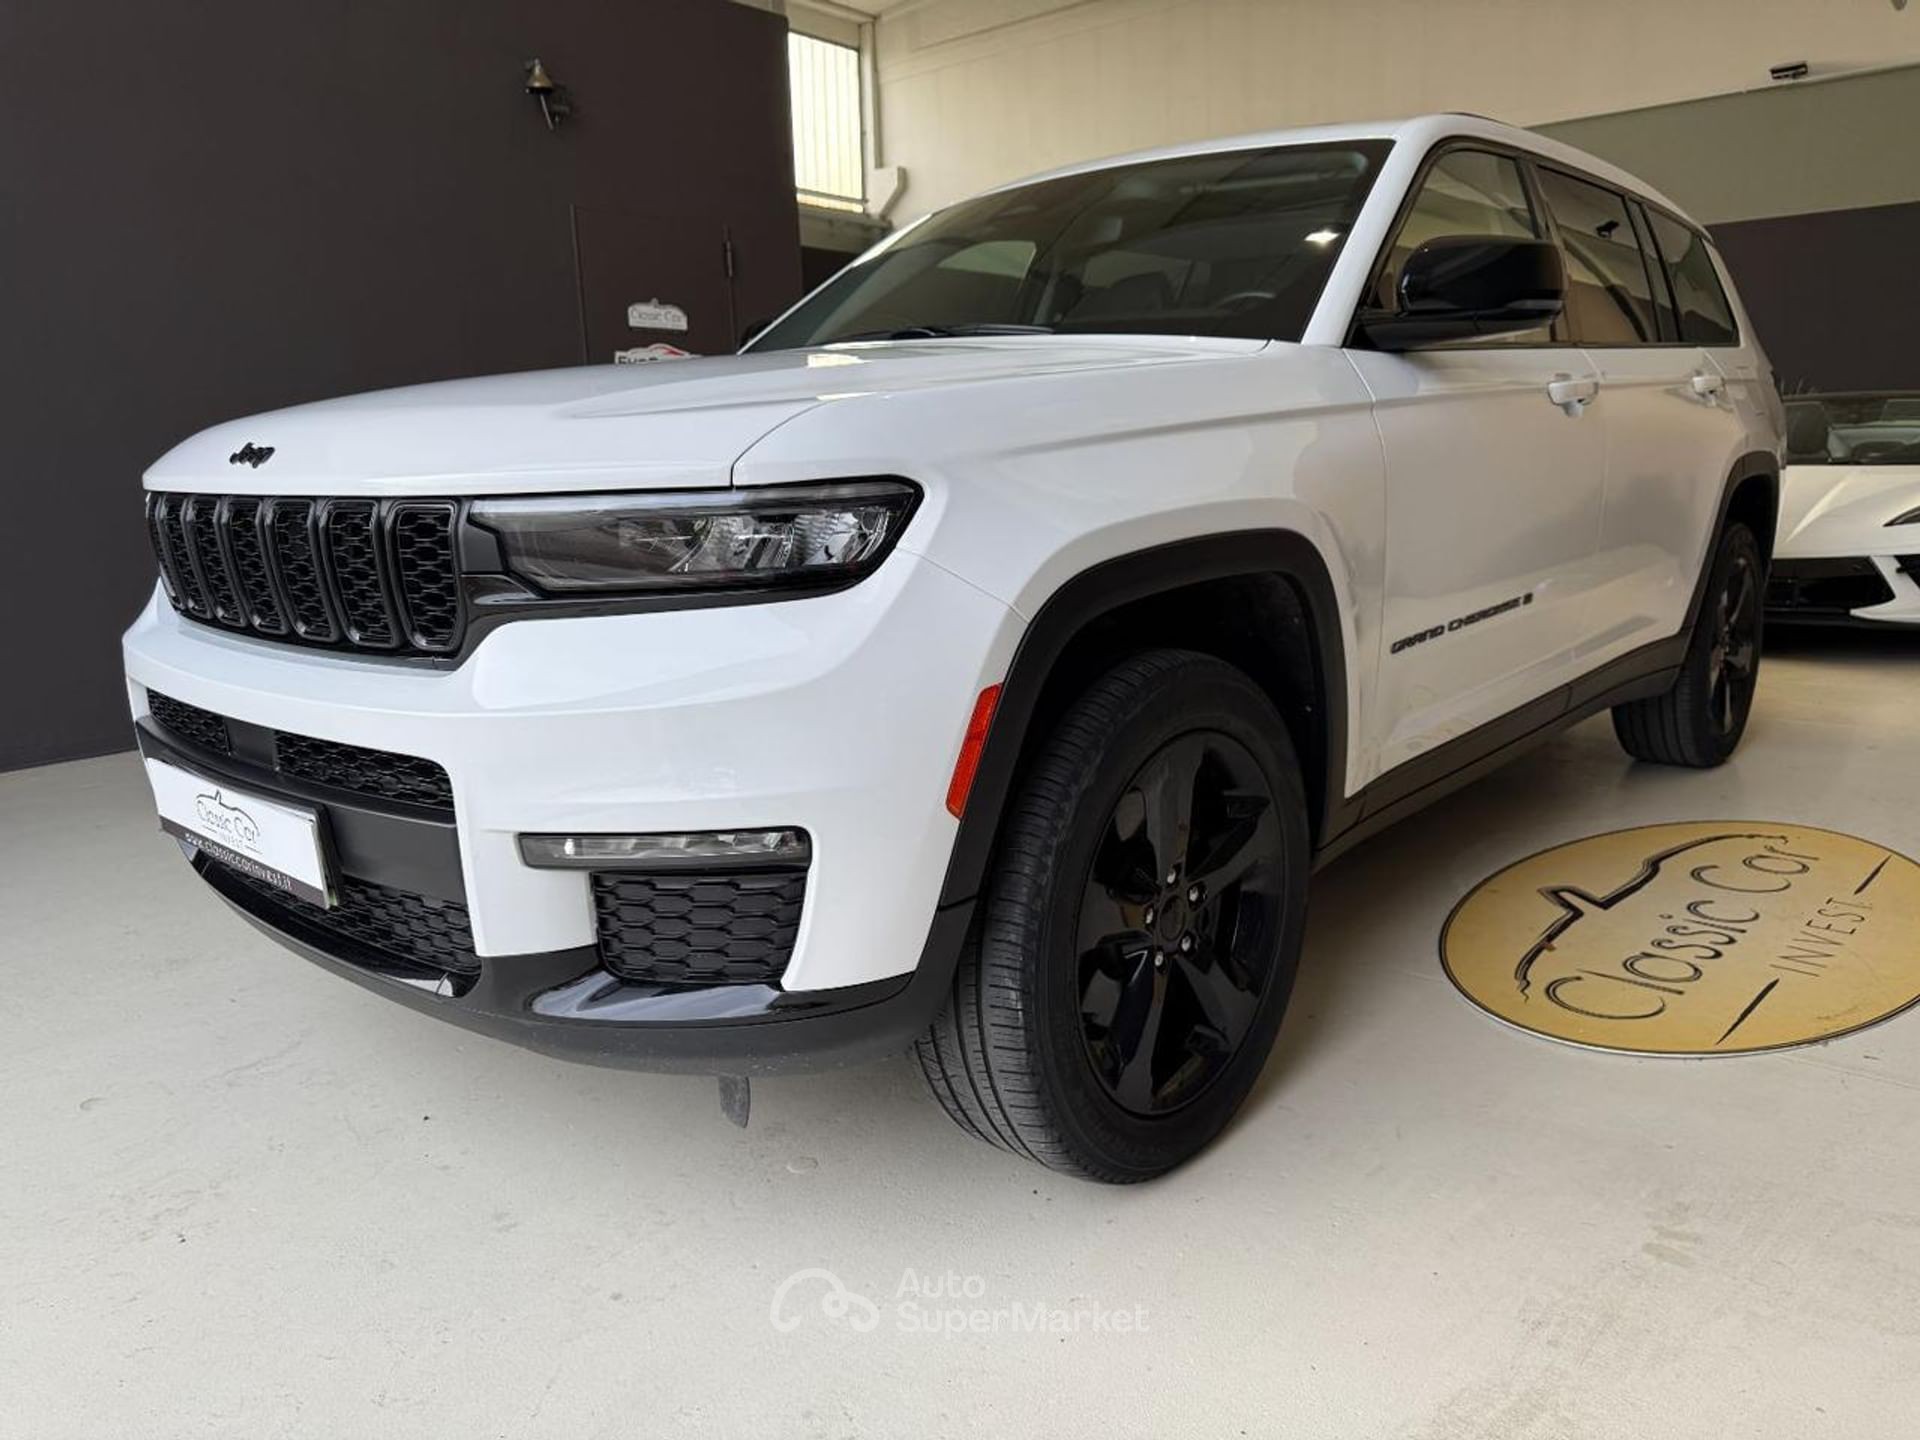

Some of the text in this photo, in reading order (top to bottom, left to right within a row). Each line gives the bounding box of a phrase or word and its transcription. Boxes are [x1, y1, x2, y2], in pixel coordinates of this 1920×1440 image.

[1391, 625, 1445, 654] GRAND
[1545, 843, 1820, 1020] Classic Car
[1769, 896, 1874, 978] INVEST
